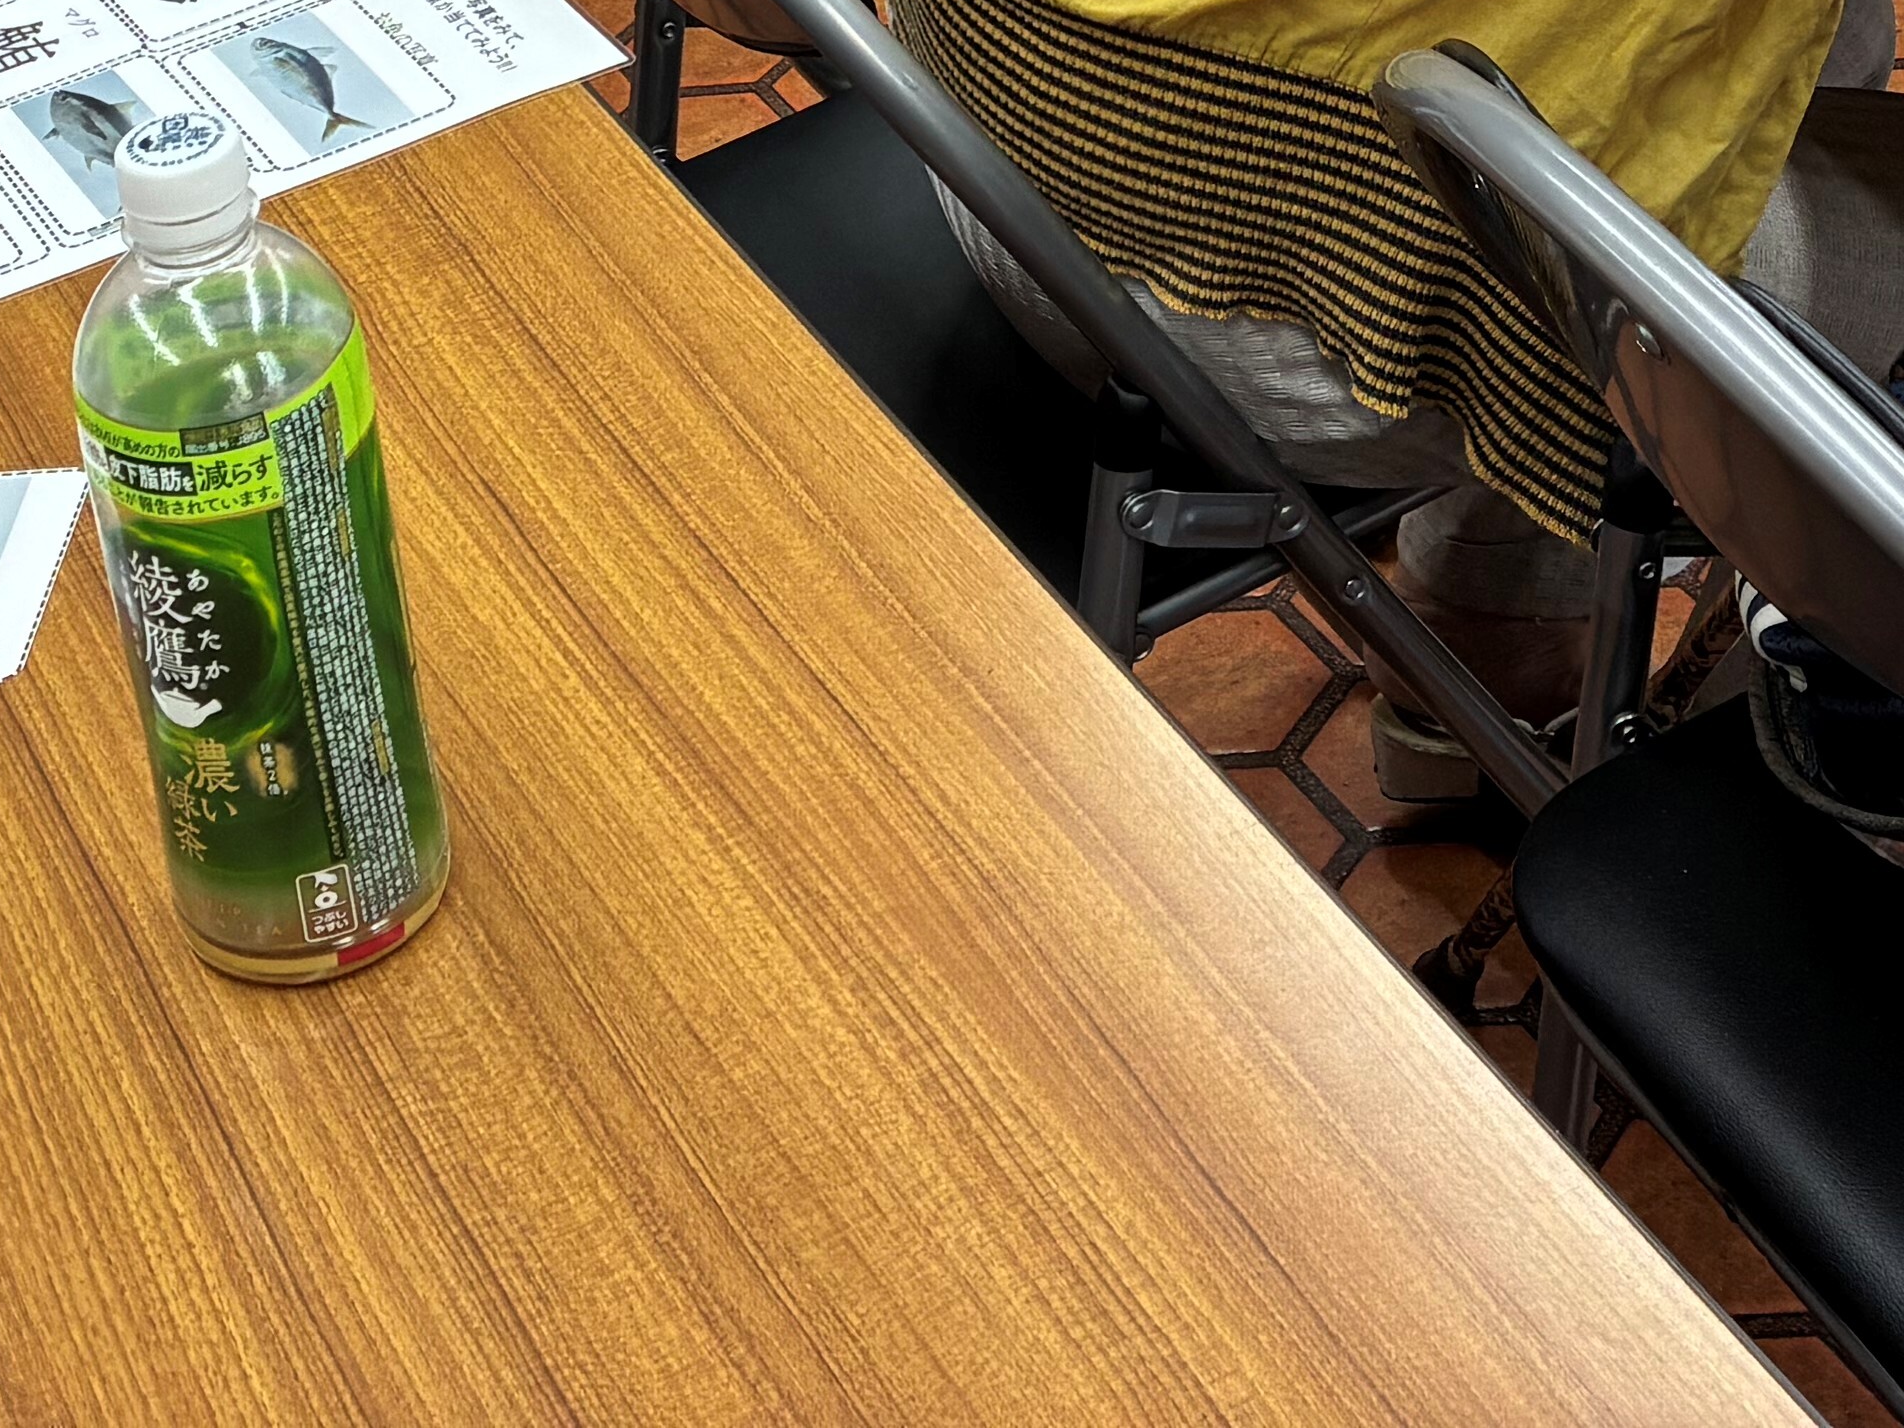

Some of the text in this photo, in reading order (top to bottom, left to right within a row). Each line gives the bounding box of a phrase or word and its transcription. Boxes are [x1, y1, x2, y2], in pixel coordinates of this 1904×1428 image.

[64, 6, 100, 39] マグロ
[127, 549, 201, 690] 綾鷹
[186, 568, 230, 681] あやたか
[165, 775, 208, 862] 緑茶
[179, 737, 240, 822] 濃い
